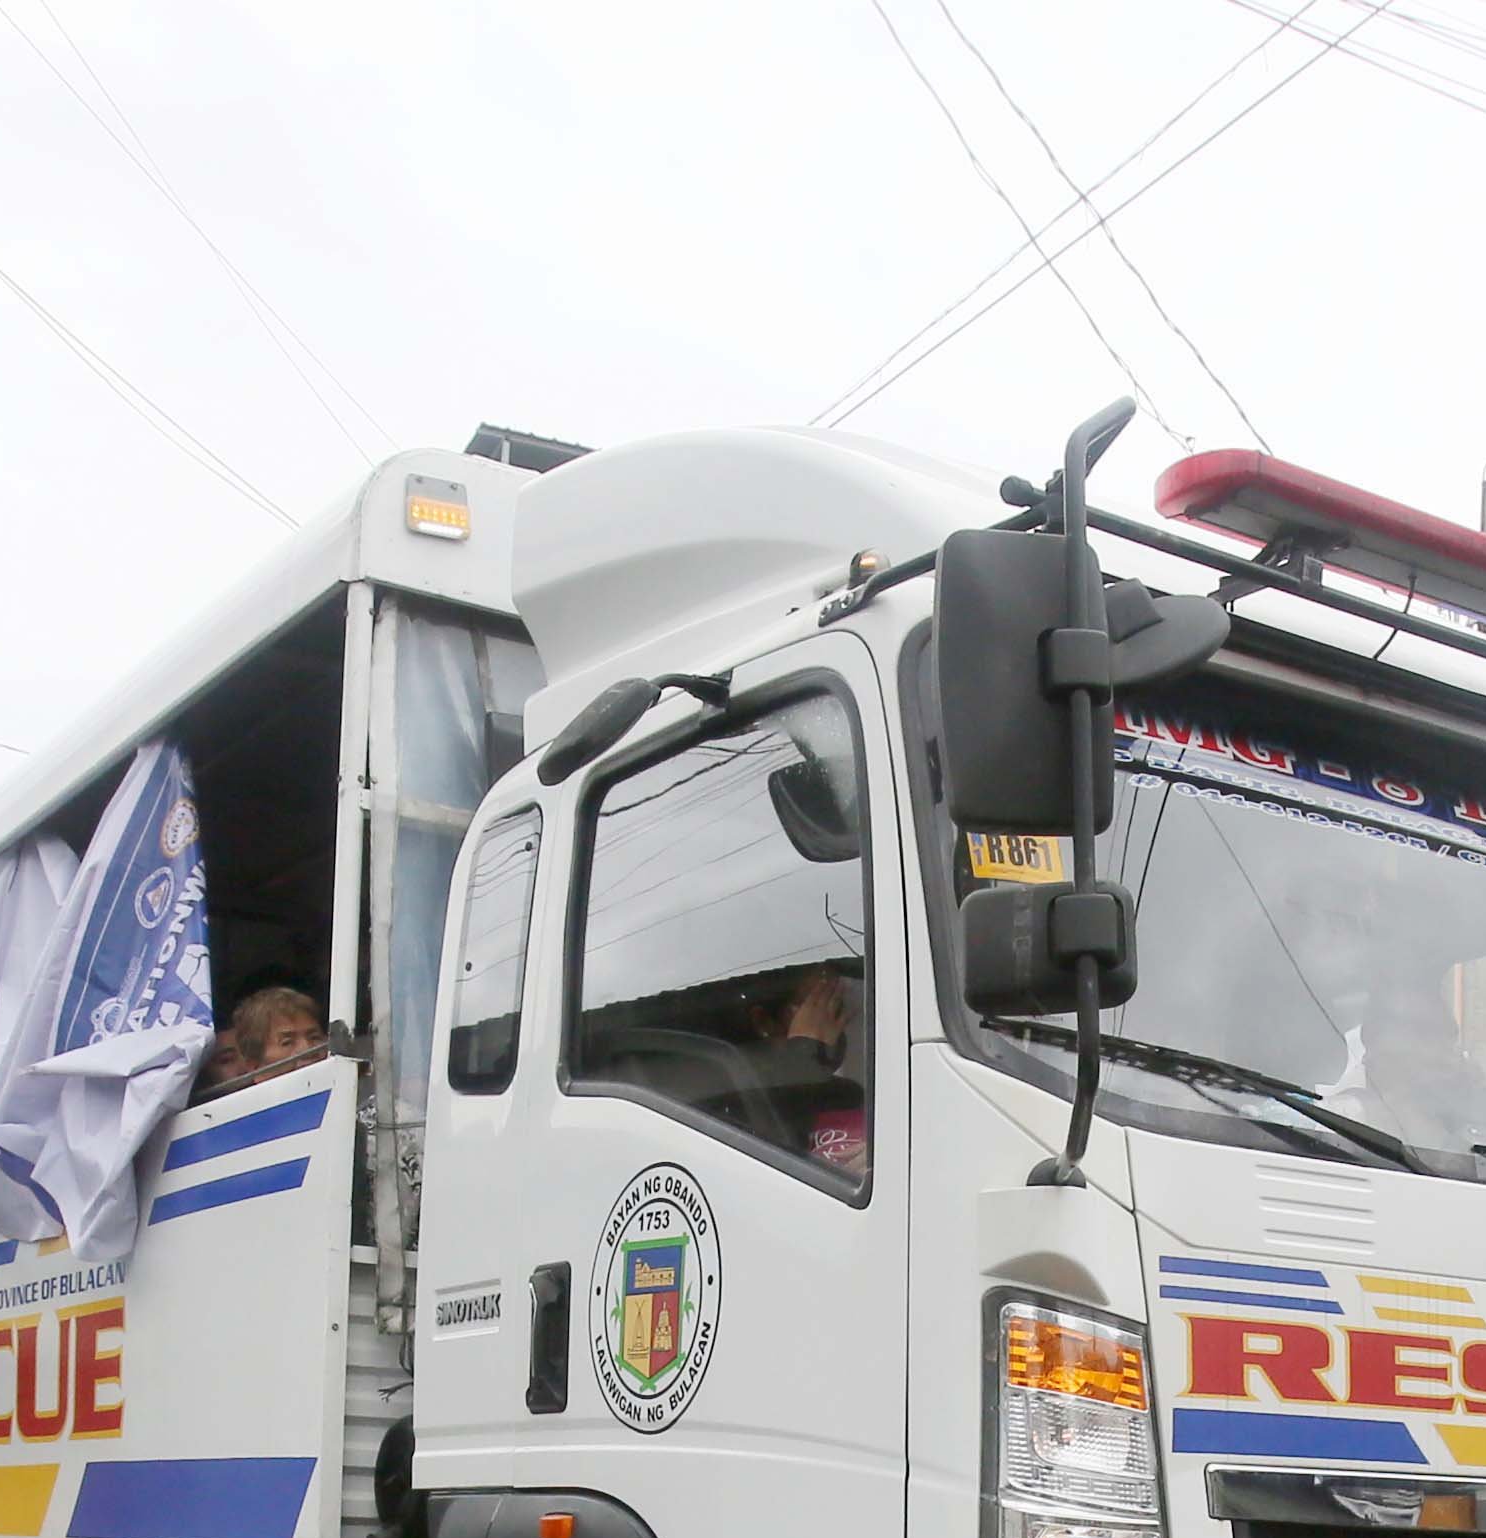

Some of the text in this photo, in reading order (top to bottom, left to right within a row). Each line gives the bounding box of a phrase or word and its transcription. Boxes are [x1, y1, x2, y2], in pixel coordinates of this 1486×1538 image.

[606, 1176, 707, 1248] BAYAN NG OBANDO
[638, 1209, 670, 1232] 1753
[41, 1277, 57, 1300] OF
[60, 1261, 126, 1296] BULACAN
[595, 1321, 711, 1422] LALAWIGAN NG BULACAN
